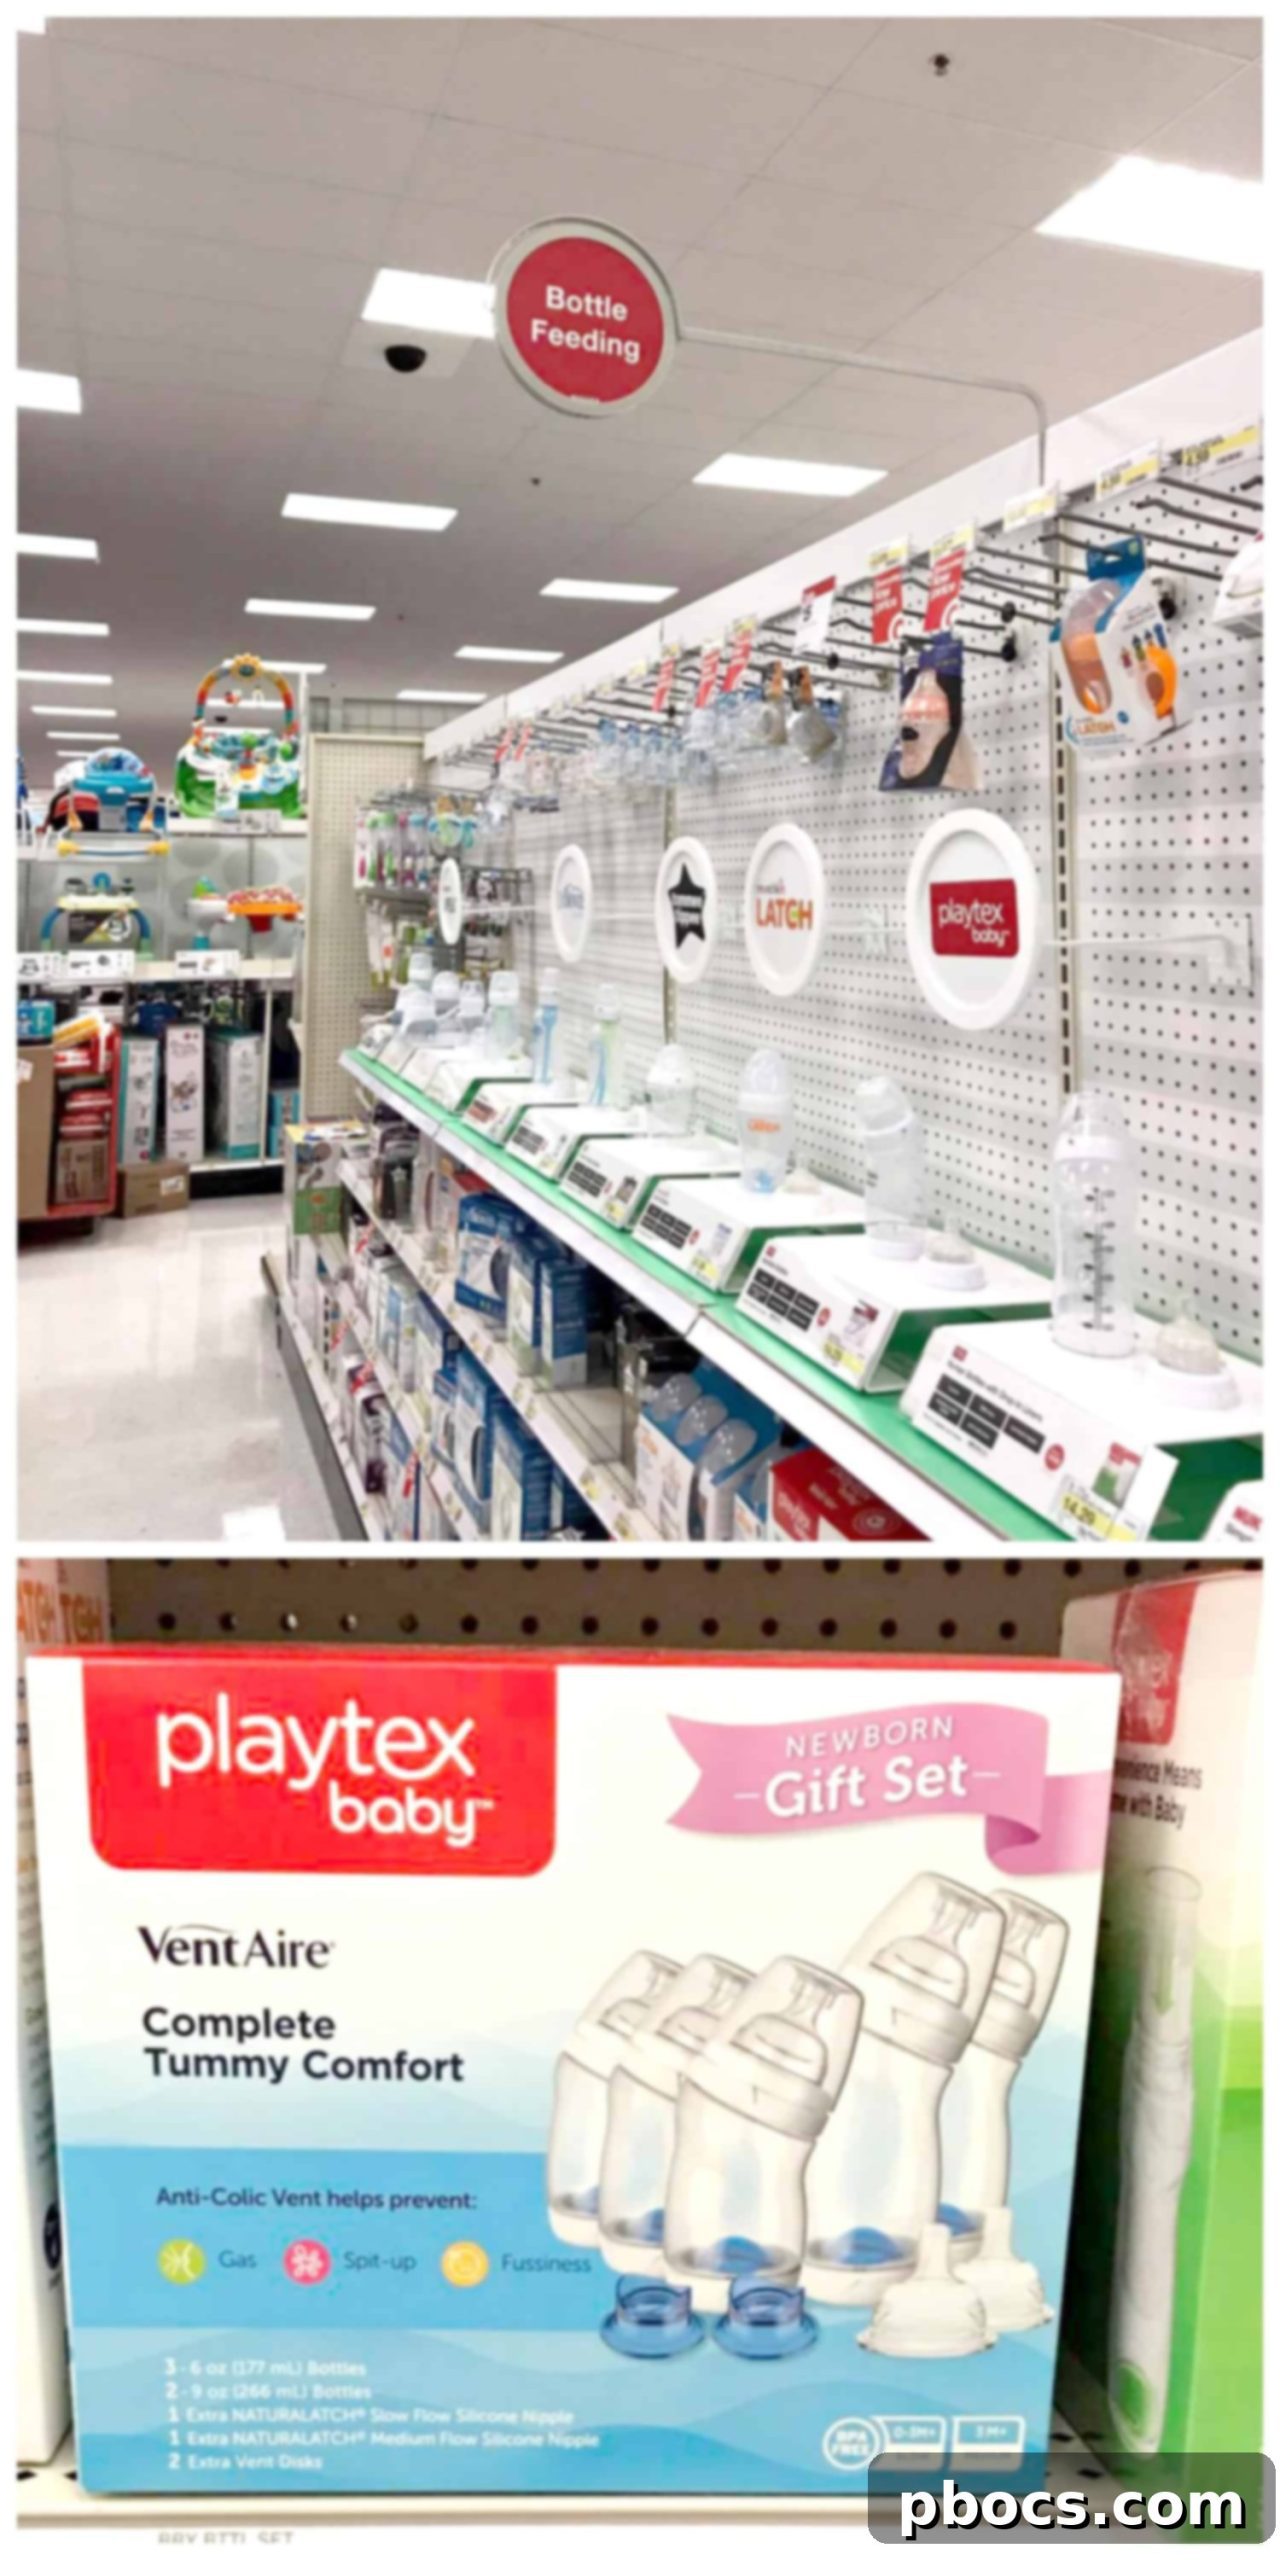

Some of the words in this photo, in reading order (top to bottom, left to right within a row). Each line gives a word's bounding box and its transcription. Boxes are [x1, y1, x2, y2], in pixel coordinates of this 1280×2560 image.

[546, 285, 628, 321] Bottle
[530, 318, 640, 365] Feeding
[755, 898, 814, 930] LATCH
[938, 897, 1005, 930] playtex
[156, 1691, 476, 1791] playtex
[785, 1715, 954, 1758] NEWBORN
[765, 1764, 866, 1818] Gift
[883, 1754, 969, 1804] Set
[142, 2006, 336, 2044] Complete
[143, 2047, 290, 2085] Tummy
[302, 2049, 465, 2083] Comfort
[156, 2186, 267, 2208] Anti-Colic
[272, 2187, 321, 2208] Vent
[326, 2188, 385, 2213] helps
[389, 2191, 478, 2212] prevent:
[218, 2250, 258, 2269] Gas
[343, 2251, 418, 2274] Spit-up
[501, 2253, 592, 2273] Fussiness
[190, 2360, 201, 2376] 6
[206, 2363, 227, 2376] oz
[307, 2360, 367, 2377] Bottles
[165, 2382, 177, 2400] 2
[207, 2387, 228, 2400] oz
[313, 2384, 372, 2401] Bottles
[168, 2406, 180, 2423] 1
[186, 2407, 228, 2423] Extra
[370, 2408, 409, 2424] Slow
[413, 2408, 450, 2424] Flow
[455, 2407, 518, 2424] Silicone
[522, 2409, 575, 2426] Nipple
[168, 2430, 180, 2446] 1
[186, 2431, 229, 2447] Extra
[371, 2431, 436, 2447] Medium
[440, 2432, 478, 2447] Flow
[481, 2431, 543, 2448] Silicone
[548, 2433, 600, 2449] Nipple
[836, 2430, 868, 2442] BPA
[168, 2453, 181, 2470] 2
[187, 2454, 231, 2470] Extra
[235, 2454, 275, 2470] Vent
[278, 2454, 324, 2470] Disks
